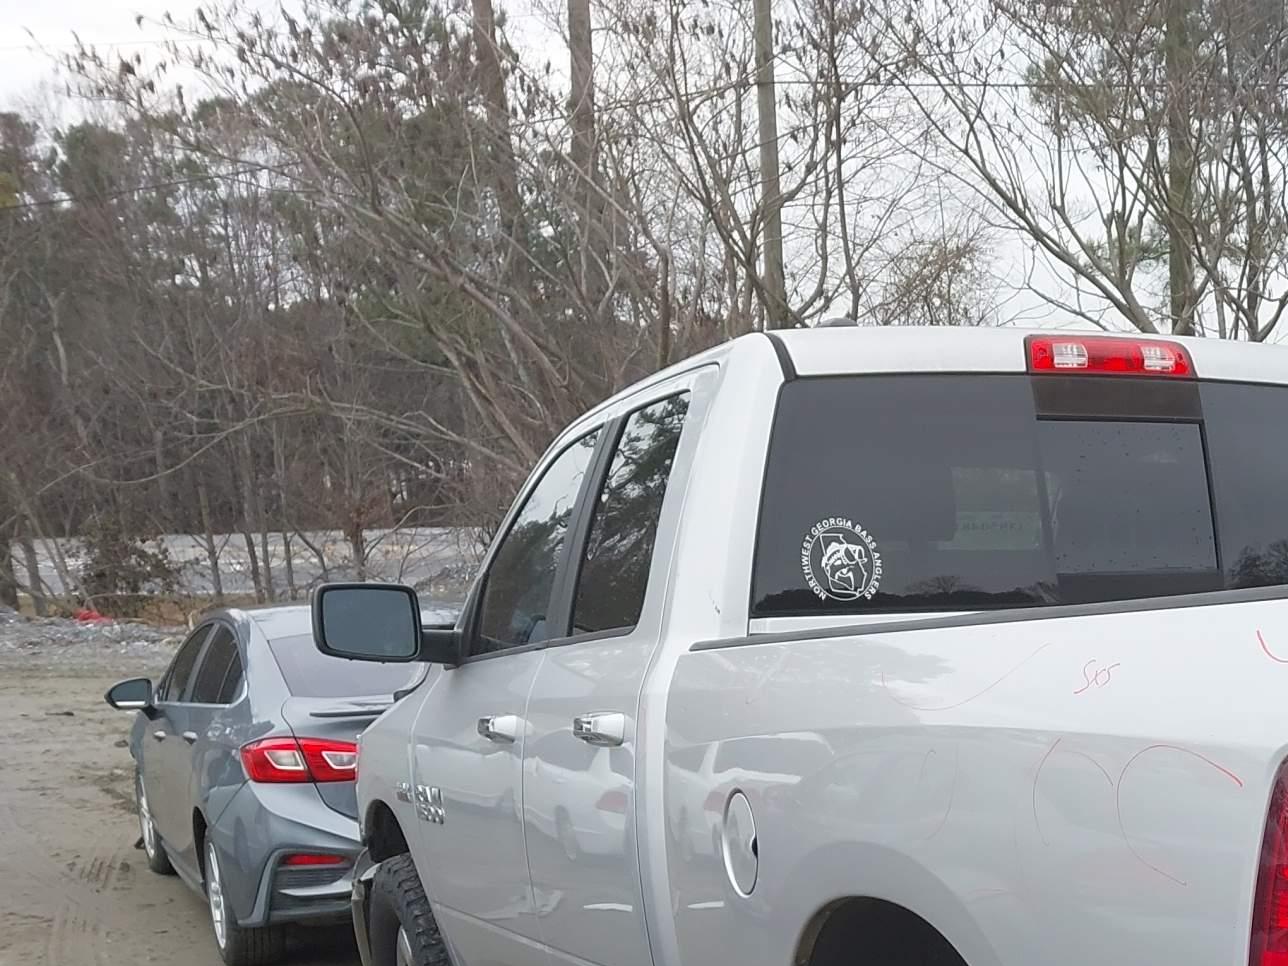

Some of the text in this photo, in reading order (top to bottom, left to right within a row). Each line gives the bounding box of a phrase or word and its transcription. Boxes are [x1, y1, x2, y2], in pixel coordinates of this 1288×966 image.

[801, 517, 883, 600] NORTHWEST GEORGIA BASS ANGLERS
